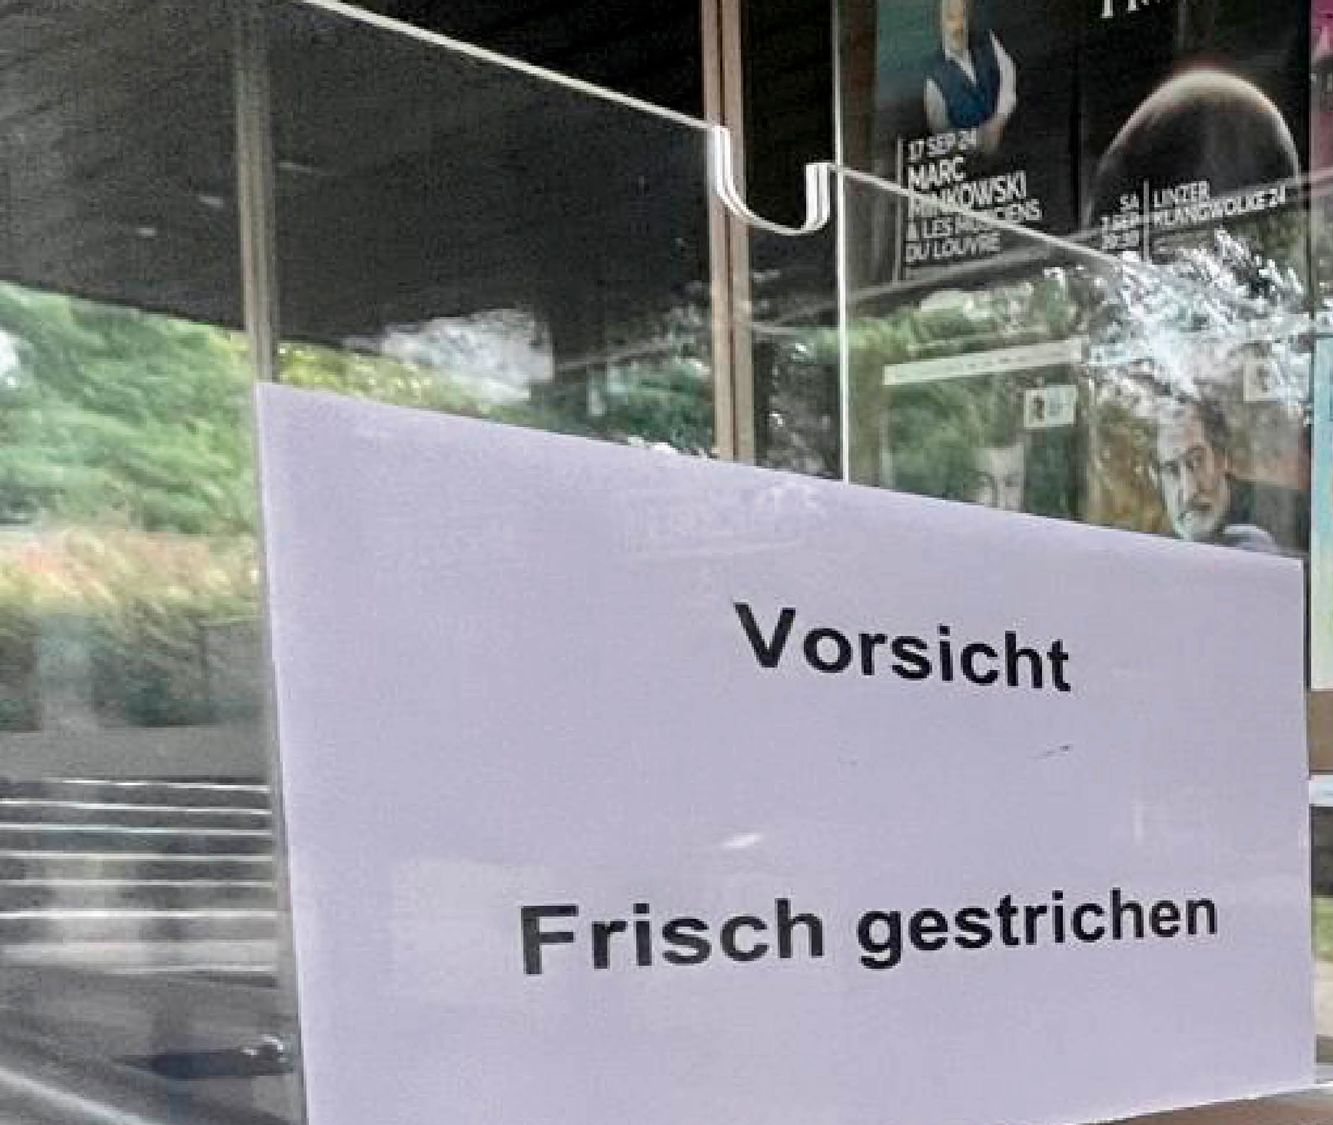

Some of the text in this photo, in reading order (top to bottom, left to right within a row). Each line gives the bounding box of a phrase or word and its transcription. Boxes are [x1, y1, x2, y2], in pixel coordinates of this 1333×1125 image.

[908, 156, 966, 190] MARC
[905, 232, 1001, 263] DU LOUVRE
[733, 601, 1073, 693] Vorsicht
[519, 886, 1219, 976] Frisch gestrichen
